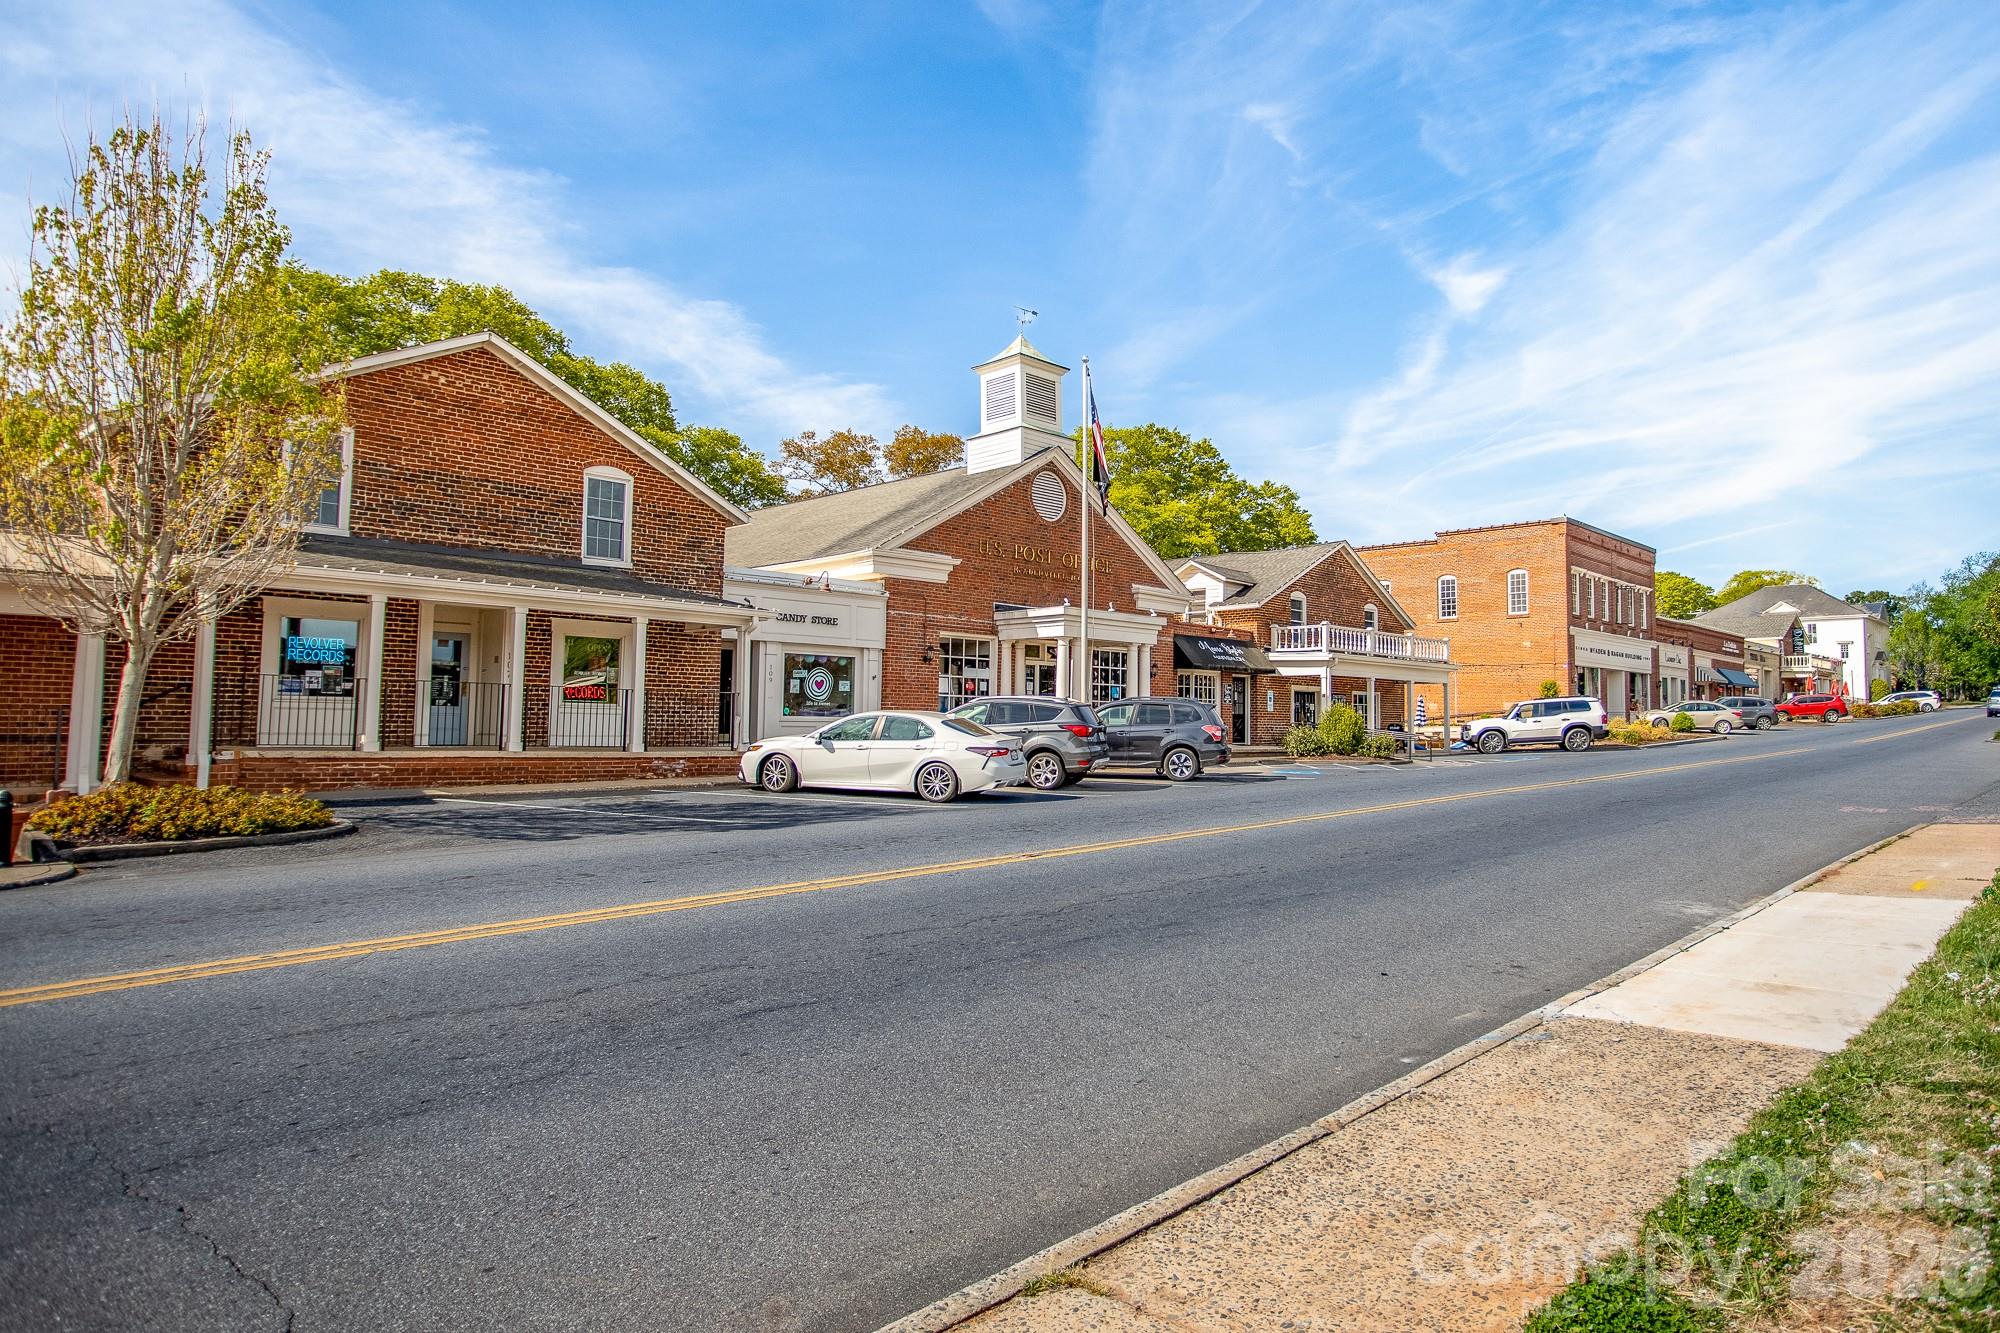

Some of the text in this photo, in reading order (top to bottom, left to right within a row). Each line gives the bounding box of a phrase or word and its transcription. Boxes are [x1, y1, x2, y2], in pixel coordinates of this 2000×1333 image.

[979, 539, 1113, 574] U.S. POST OFICE
[775, 612, 839, 626] CANDY STORE
[288, 636, 345, 650] REVOLVER
[287, 648, 345, 662] RECORDS
[1625, 652, 1643, 661] BUILDING
[563, 685, 606, 699] RECORDS
